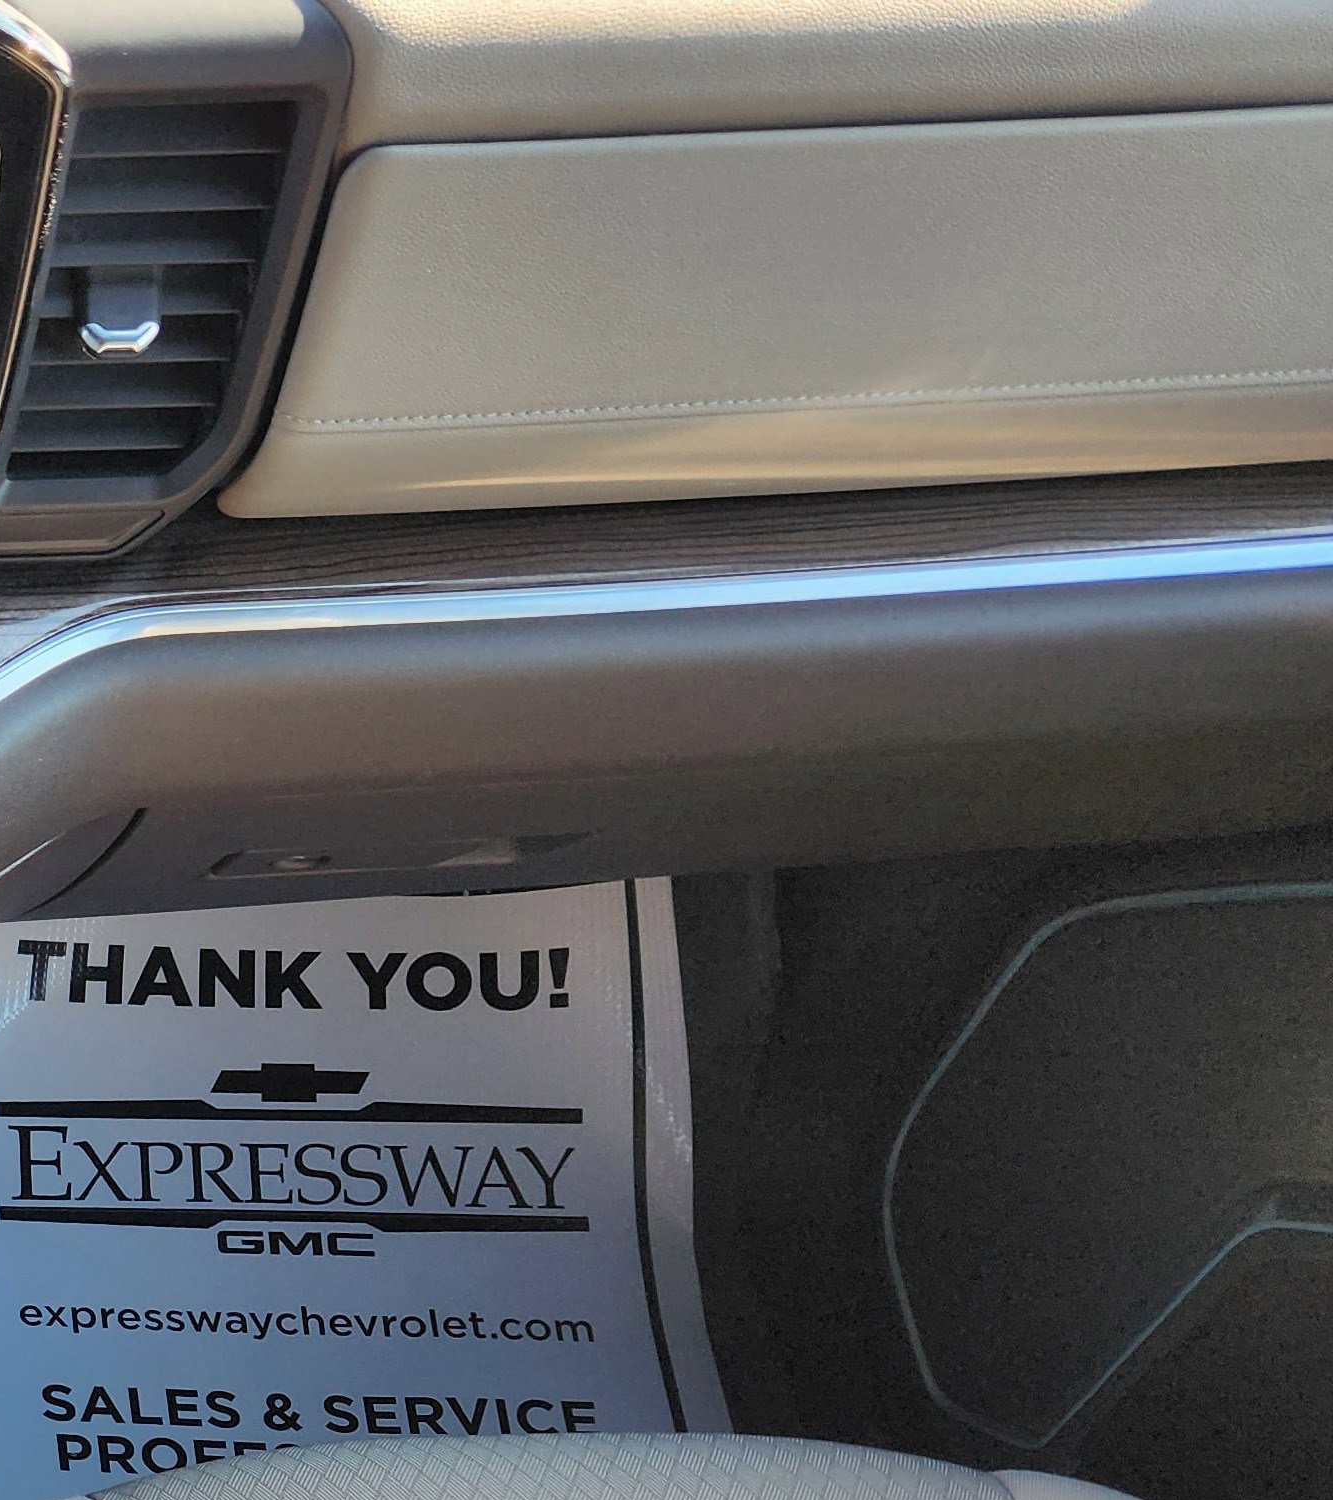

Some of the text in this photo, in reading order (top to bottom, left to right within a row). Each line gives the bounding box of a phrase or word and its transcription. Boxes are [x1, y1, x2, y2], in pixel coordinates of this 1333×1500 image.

[17, 940, 571, 1011] THANK YOU!
[217, 1231, 376, 1257] GMC
[19, 1300, 595, 1344] expresswaychevrolet.com
[42, 1384, 597, 1434] SALES & SERVICE
